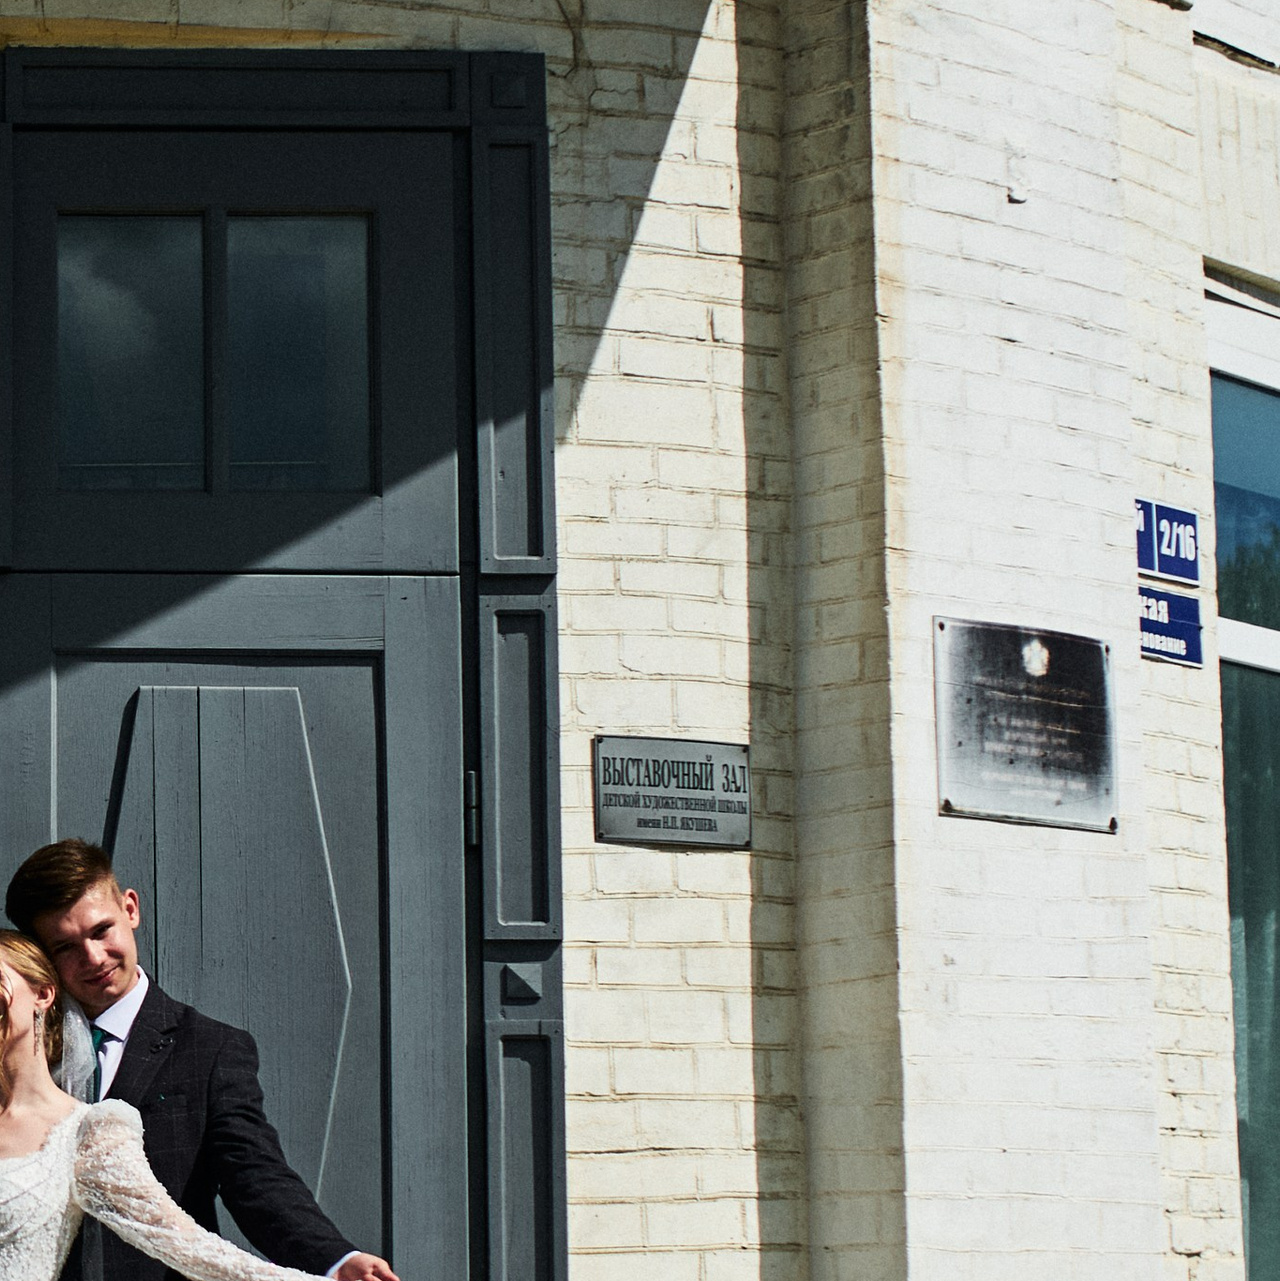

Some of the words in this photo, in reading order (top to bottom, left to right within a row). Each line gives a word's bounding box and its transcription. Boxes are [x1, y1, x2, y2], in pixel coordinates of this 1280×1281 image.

[1159, 519, 1196, 561] 2/16
[602, 754, 715, 791] ВЫСТАВОЧНЫЙ
[722, 763, 748, 793] ЗАЛ
[602, 791, 641, 809] ДЕТСКОЙ
[642, 794, 716, 812] ХУДОЖЕСТВЕННОЙ
[718, 799, 748, 815] ШКОЛЫ
[680, 817, 718, 832] ЯКУШЕВА
